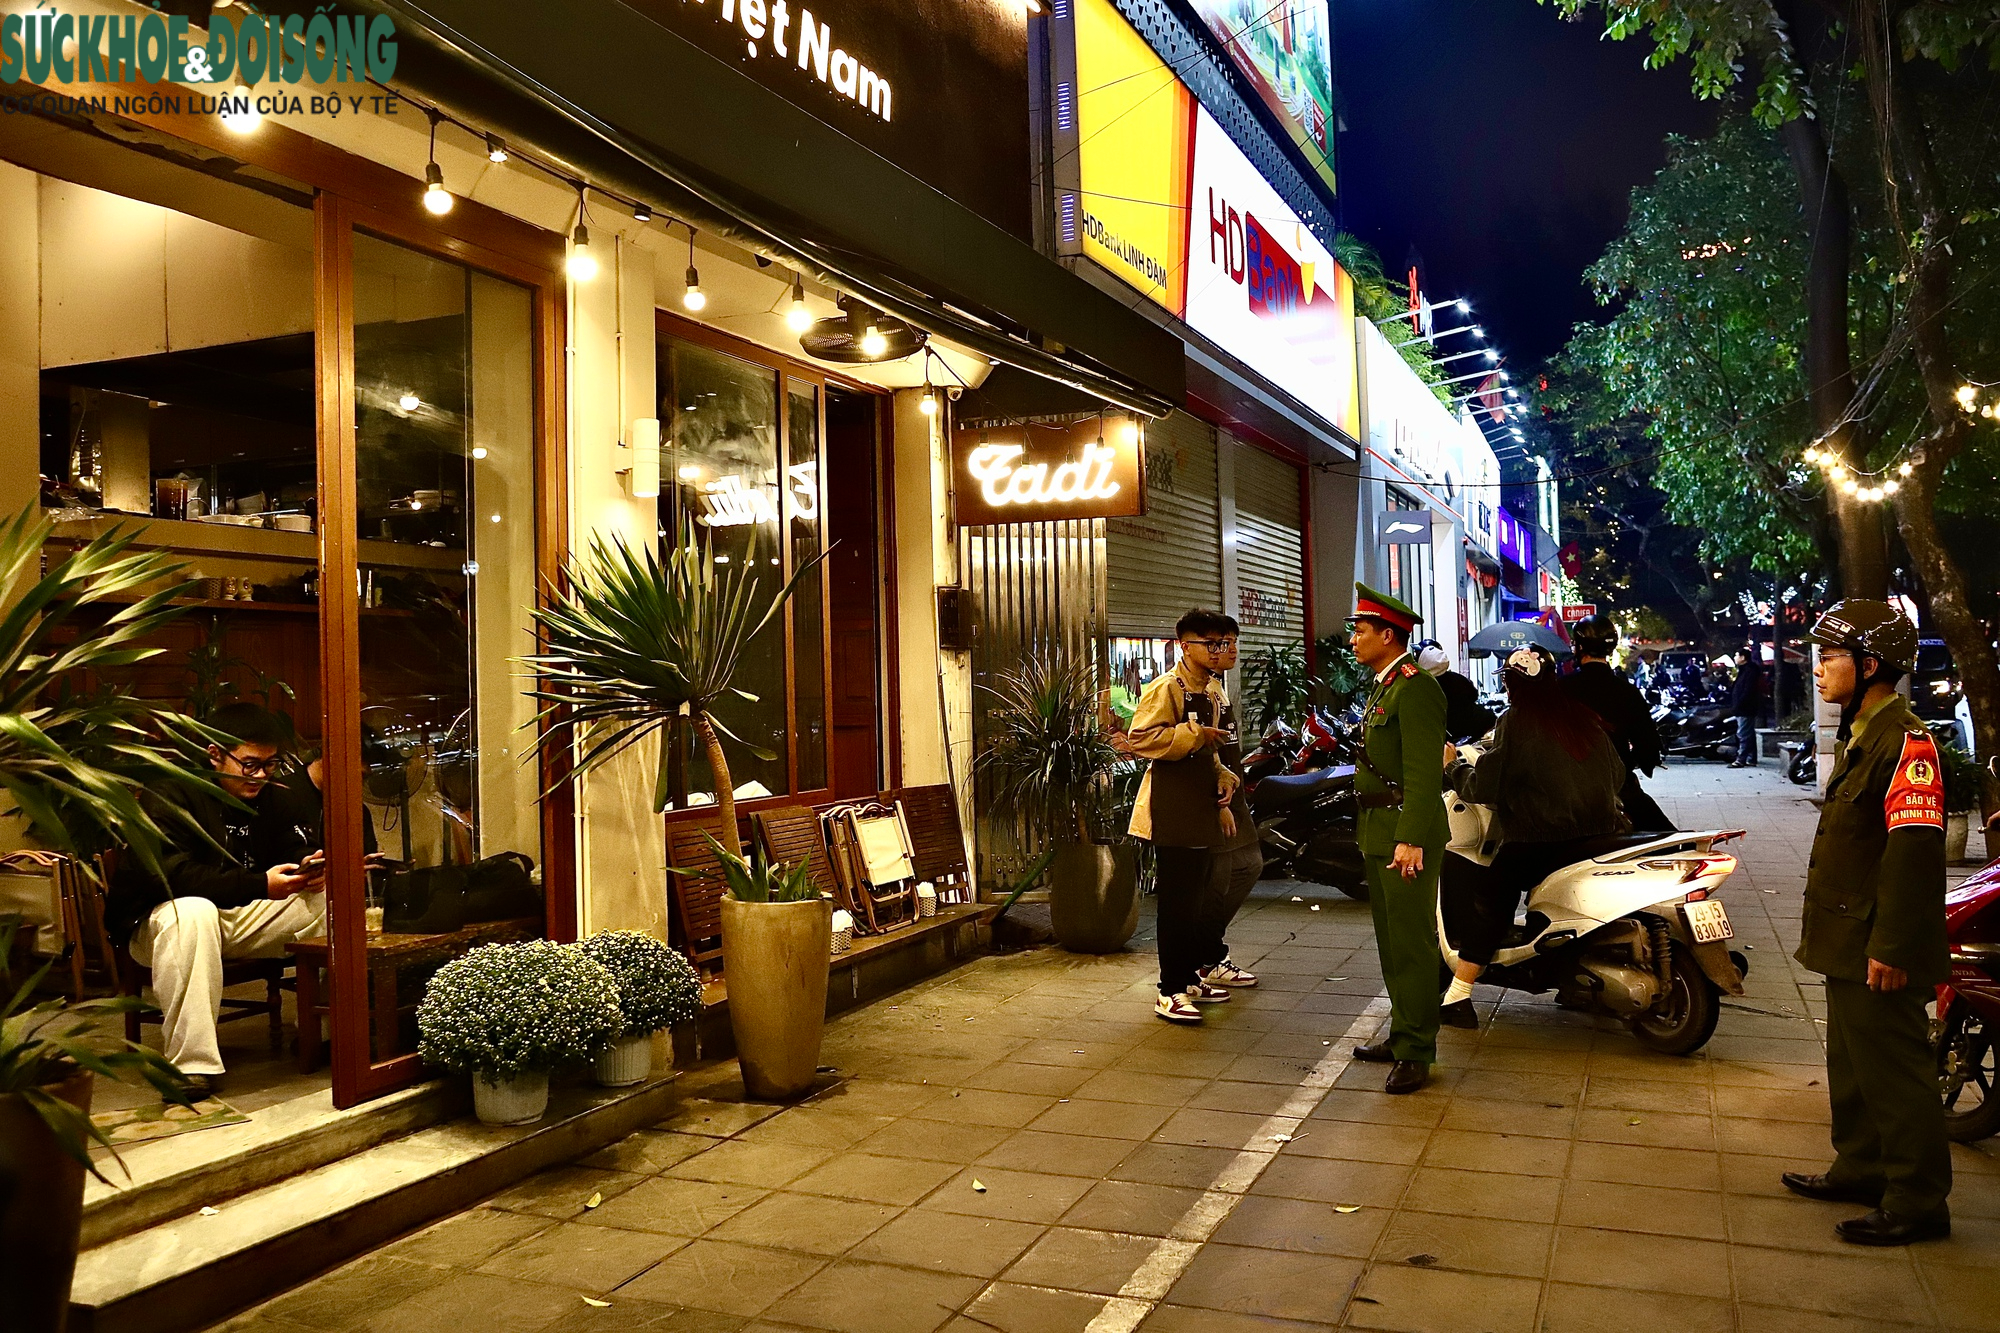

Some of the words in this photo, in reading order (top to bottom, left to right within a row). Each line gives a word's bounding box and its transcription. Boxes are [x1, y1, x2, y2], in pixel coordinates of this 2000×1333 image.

[798, 8, 892, 122] Nam
[1082, 209, 1122, 258] HDBank
[1123, 240, 1145, 274] LINH
[1146, 257, 1167, 289] ĐÀM
[1209, 186, 1299, 320] HDBank
[968, 444, 1121, 507] Tadi
[1900, 809, 1923, 819] NINH
[1906, 792, 1924, 805] BẢO
[1926, 795, 1937, 809] VỆ
[1695, 920, 1731, 940] 830.19
